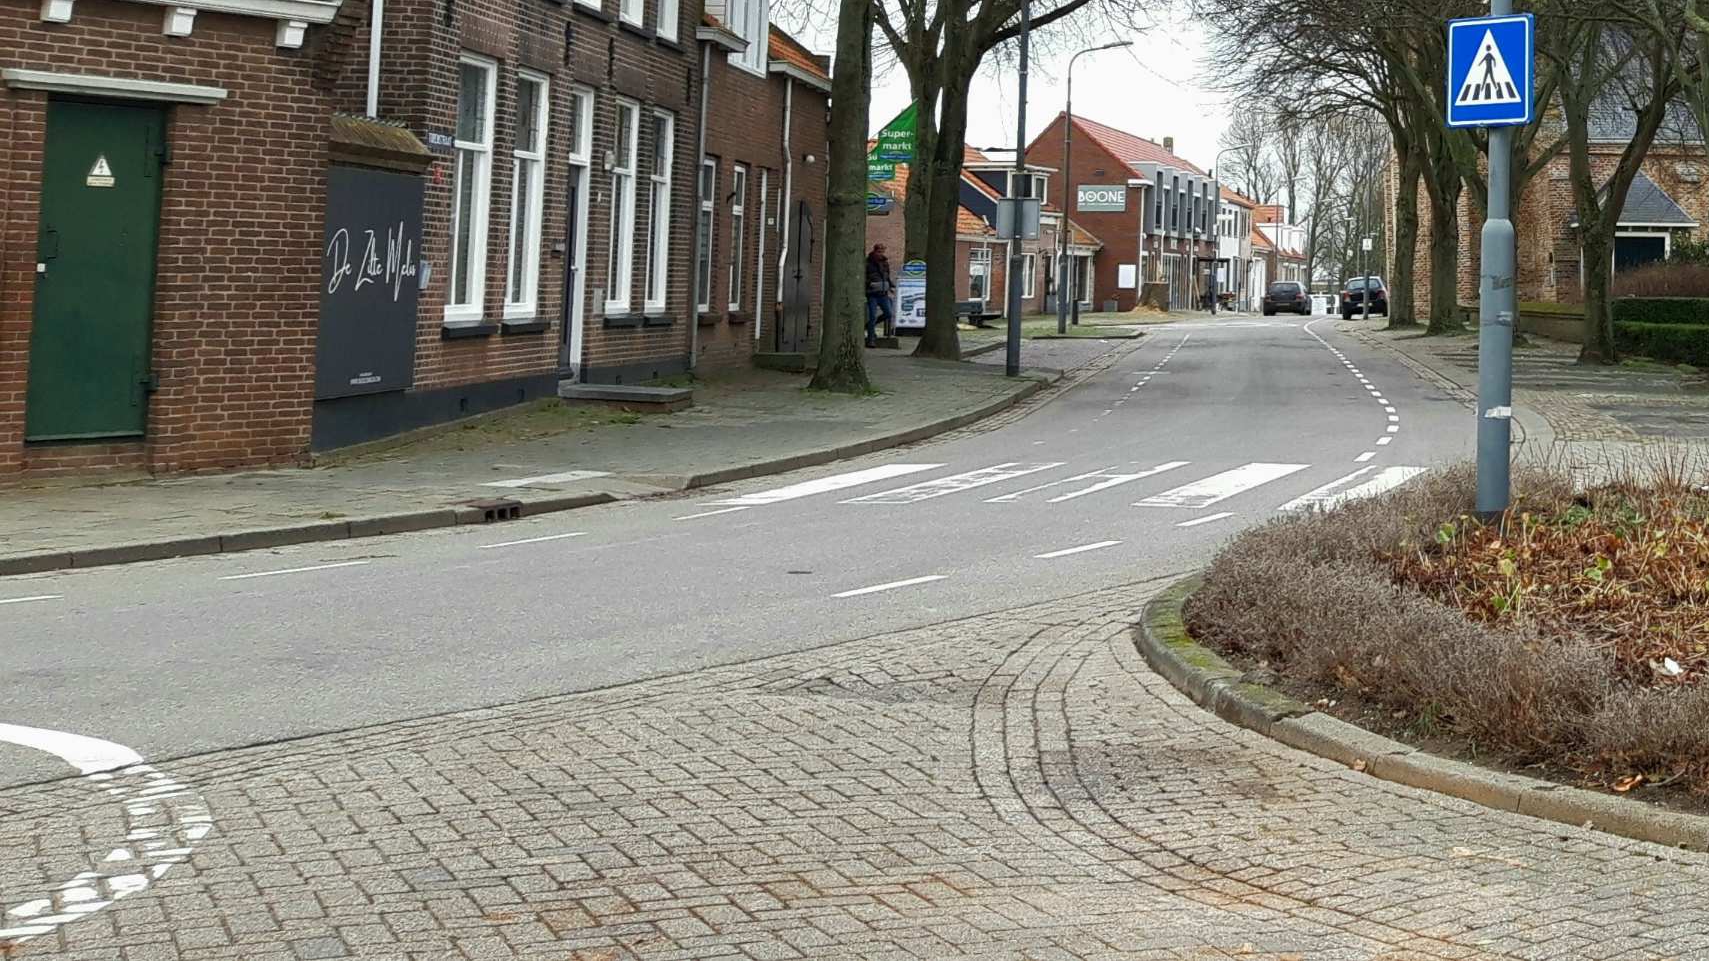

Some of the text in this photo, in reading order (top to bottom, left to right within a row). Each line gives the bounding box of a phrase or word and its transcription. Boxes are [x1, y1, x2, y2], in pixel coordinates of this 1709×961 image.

[881, 129, 914, 139] Super-
[883, 142, 912, 150] markt
[869, 162, 893, 171] markt
[1078, 190, 1125, 202] BOONE
[326, 227, 352, 294] De
